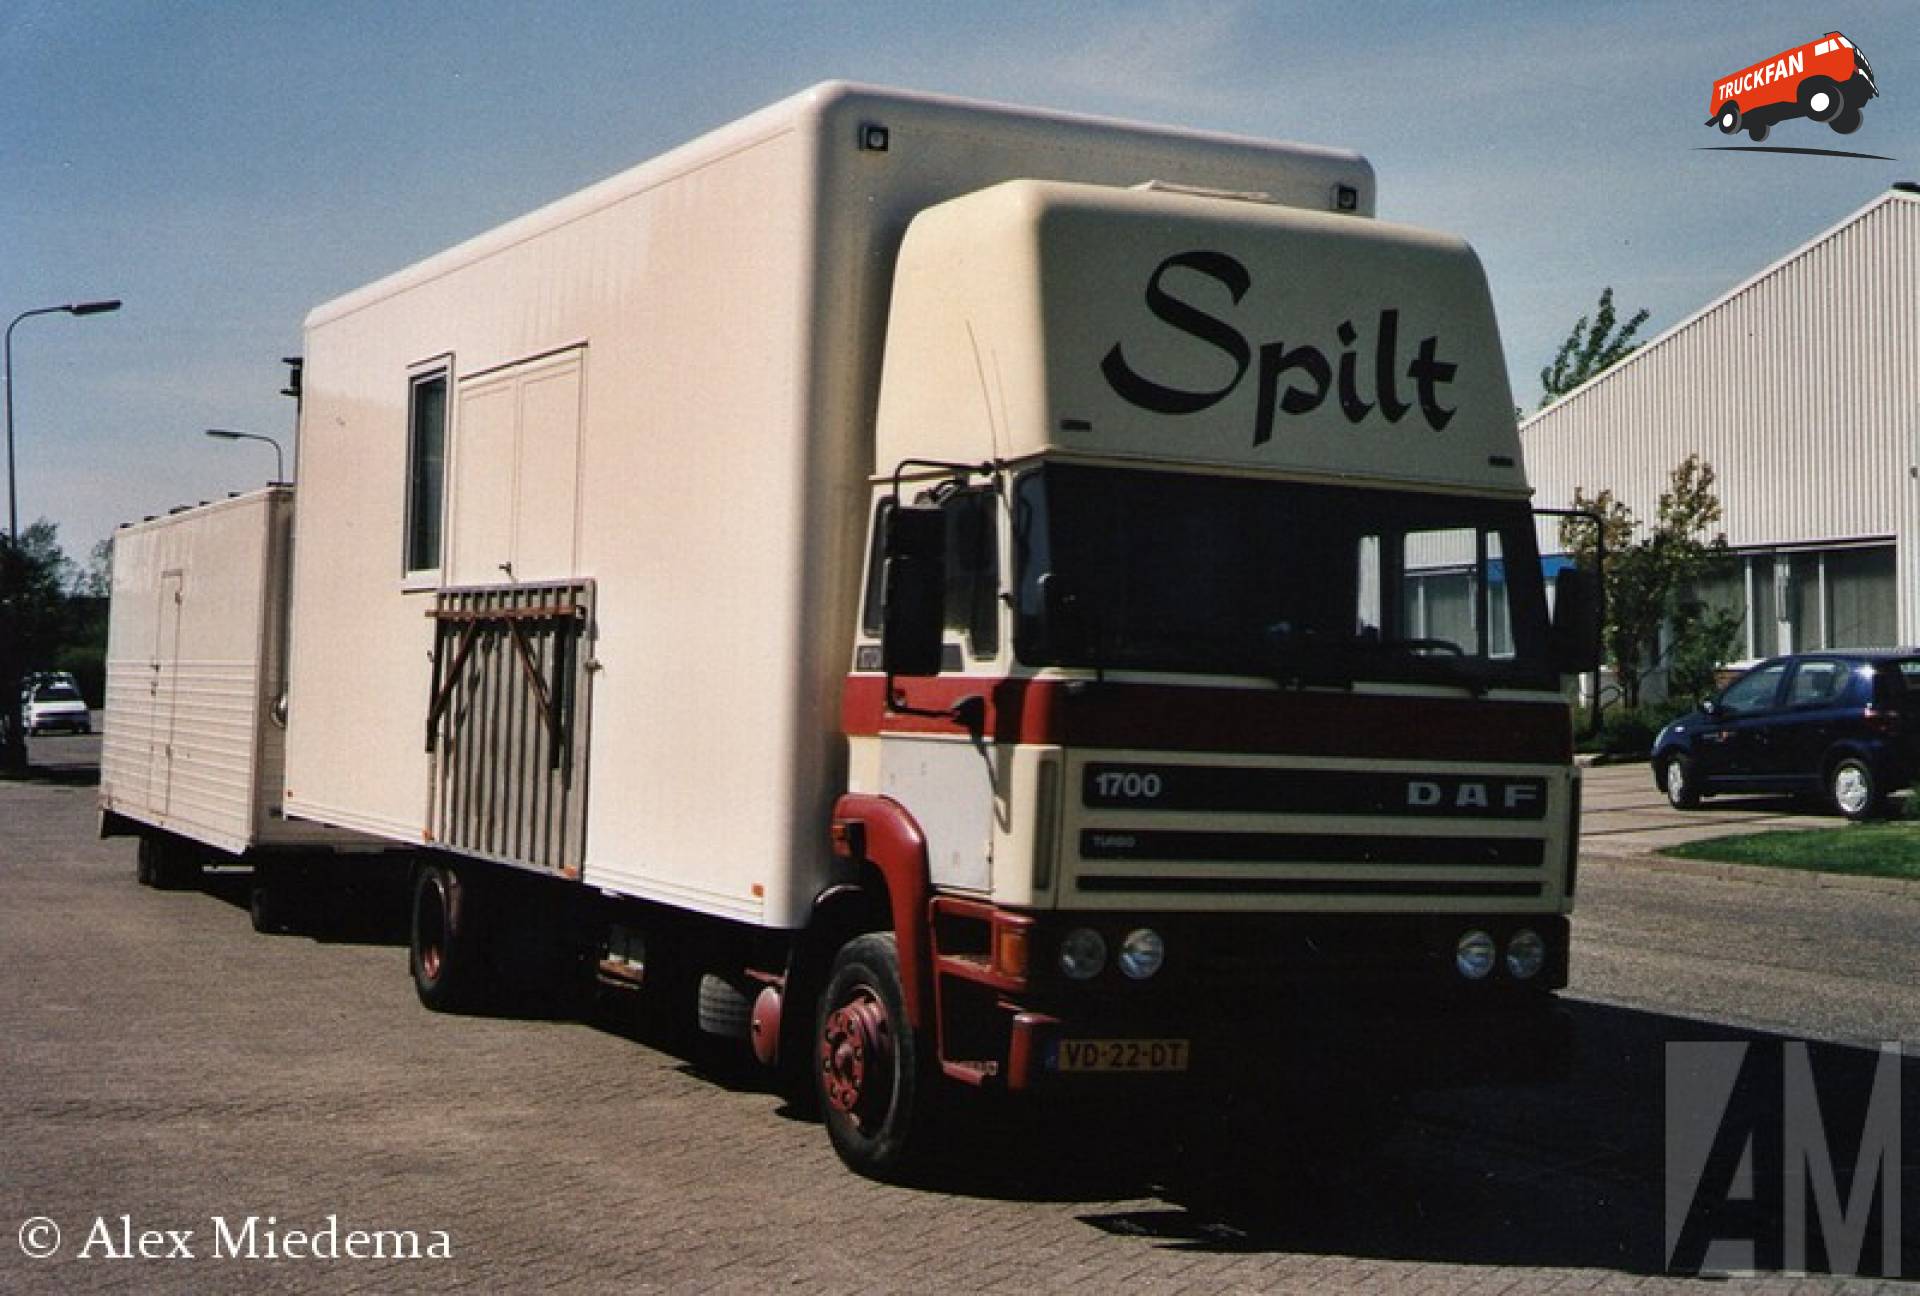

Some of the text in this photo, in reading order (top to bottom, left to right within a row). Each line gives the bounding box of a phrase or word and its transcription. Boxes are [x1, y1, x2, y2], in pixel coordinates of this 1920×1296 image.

[1101, 250, 1458, 448] Spilt
[1095, 773, 1537, 807] 1700 DAF
[1066, 1043, 1184, 1067] VD-22-DT
